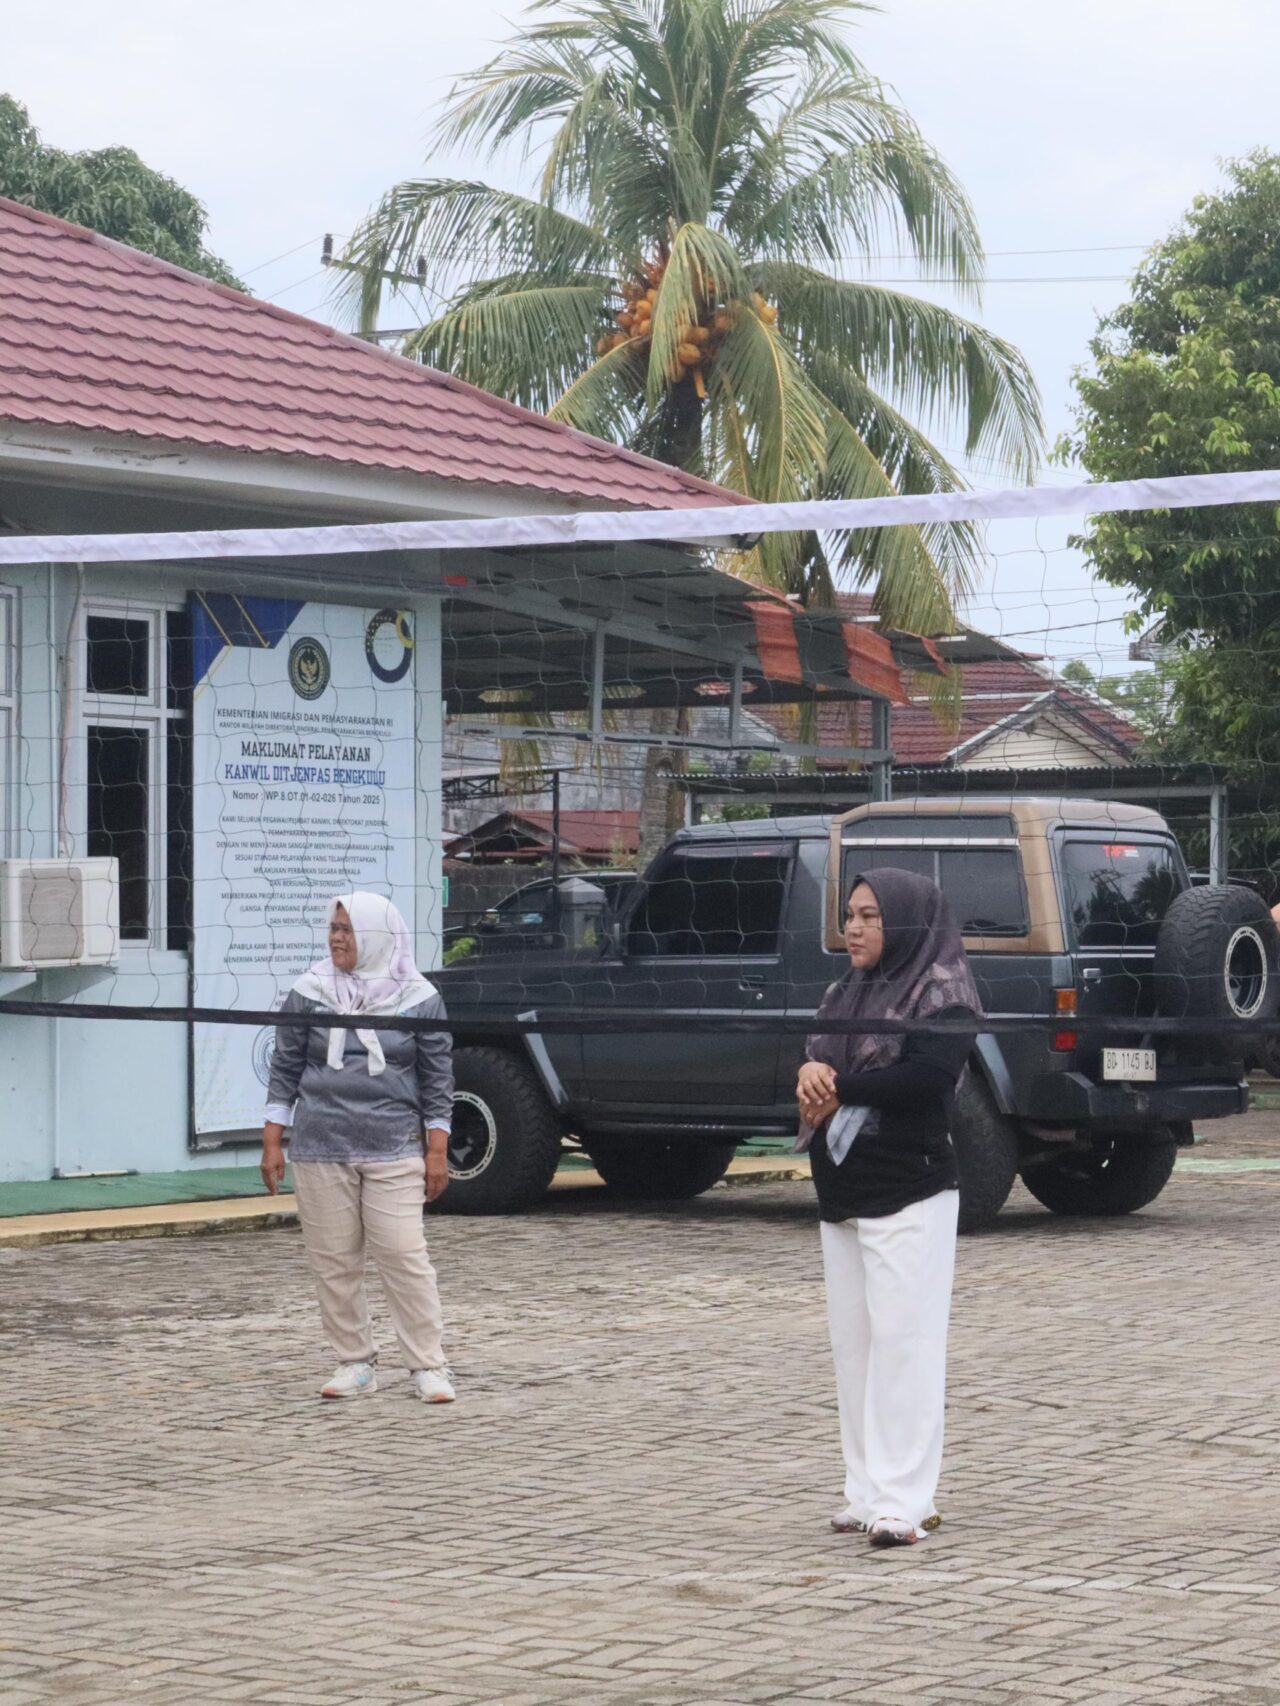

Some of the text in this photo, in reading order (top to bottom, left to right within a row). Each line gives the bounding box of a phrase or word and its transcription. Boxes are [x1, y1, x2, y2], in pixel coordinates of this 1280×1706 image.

[217, 708, 394, 727] KEMENTERIAN IMIGRASI DAN PEMASYARAKATAN RI
[241, 741, 371, 762] MAKLUMAT PELAYANAN
[225, 764, 386, 785] KANWIL DITJENPAS BENGKULU
[232, 790, 259, 800] Nomor
[338, 793, 361, 804] Tahun
[362, 794, 380, 804] 2025
[1122, 1052, 1140, 1070] 1145
